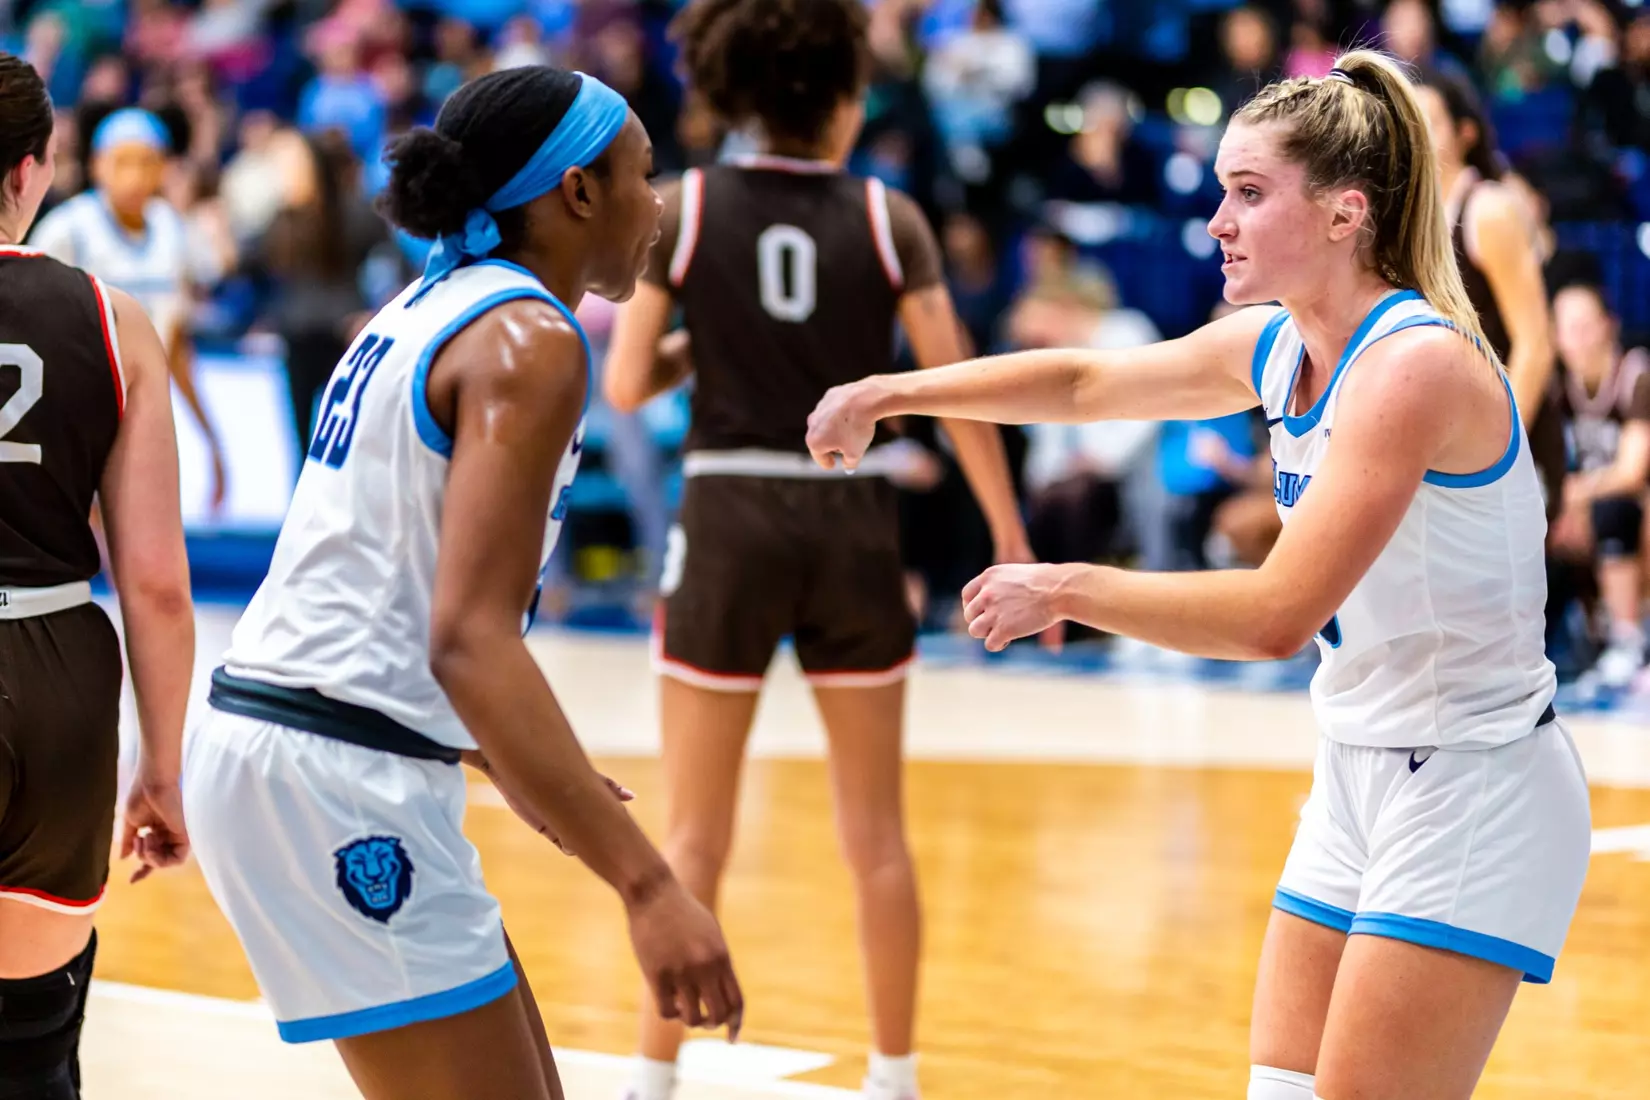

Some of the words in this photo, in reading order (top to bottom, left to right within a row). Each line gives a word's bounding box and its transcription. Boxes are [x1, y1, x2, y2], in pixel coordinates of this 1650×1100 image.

[758, 224, 817, 322] 0
[0, 342, 44, 465] 2
[308, 332, 395, 471] 23
